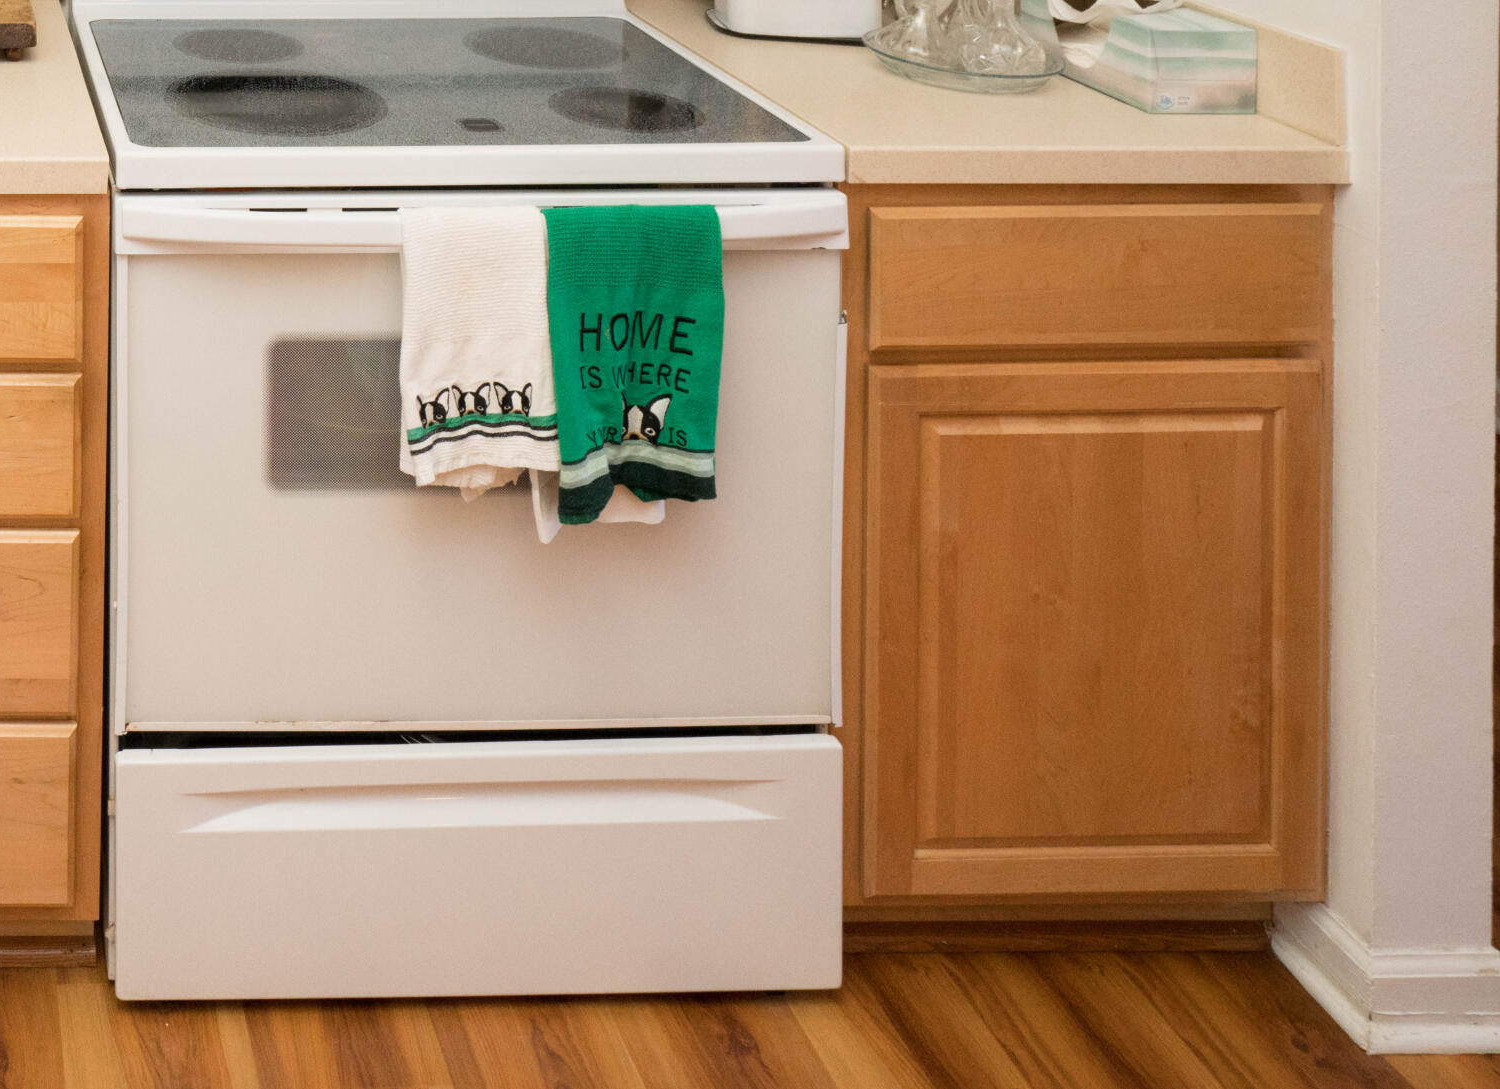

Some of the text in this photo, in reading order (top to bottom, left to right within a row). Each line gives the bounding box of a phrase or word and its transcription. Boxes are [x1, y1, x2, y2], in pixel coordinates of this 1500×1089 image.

[579, 310, 697, 356] HOME
[579, 361, 692, 395] IS WHERE
[668, 426, 688, 447] IS
